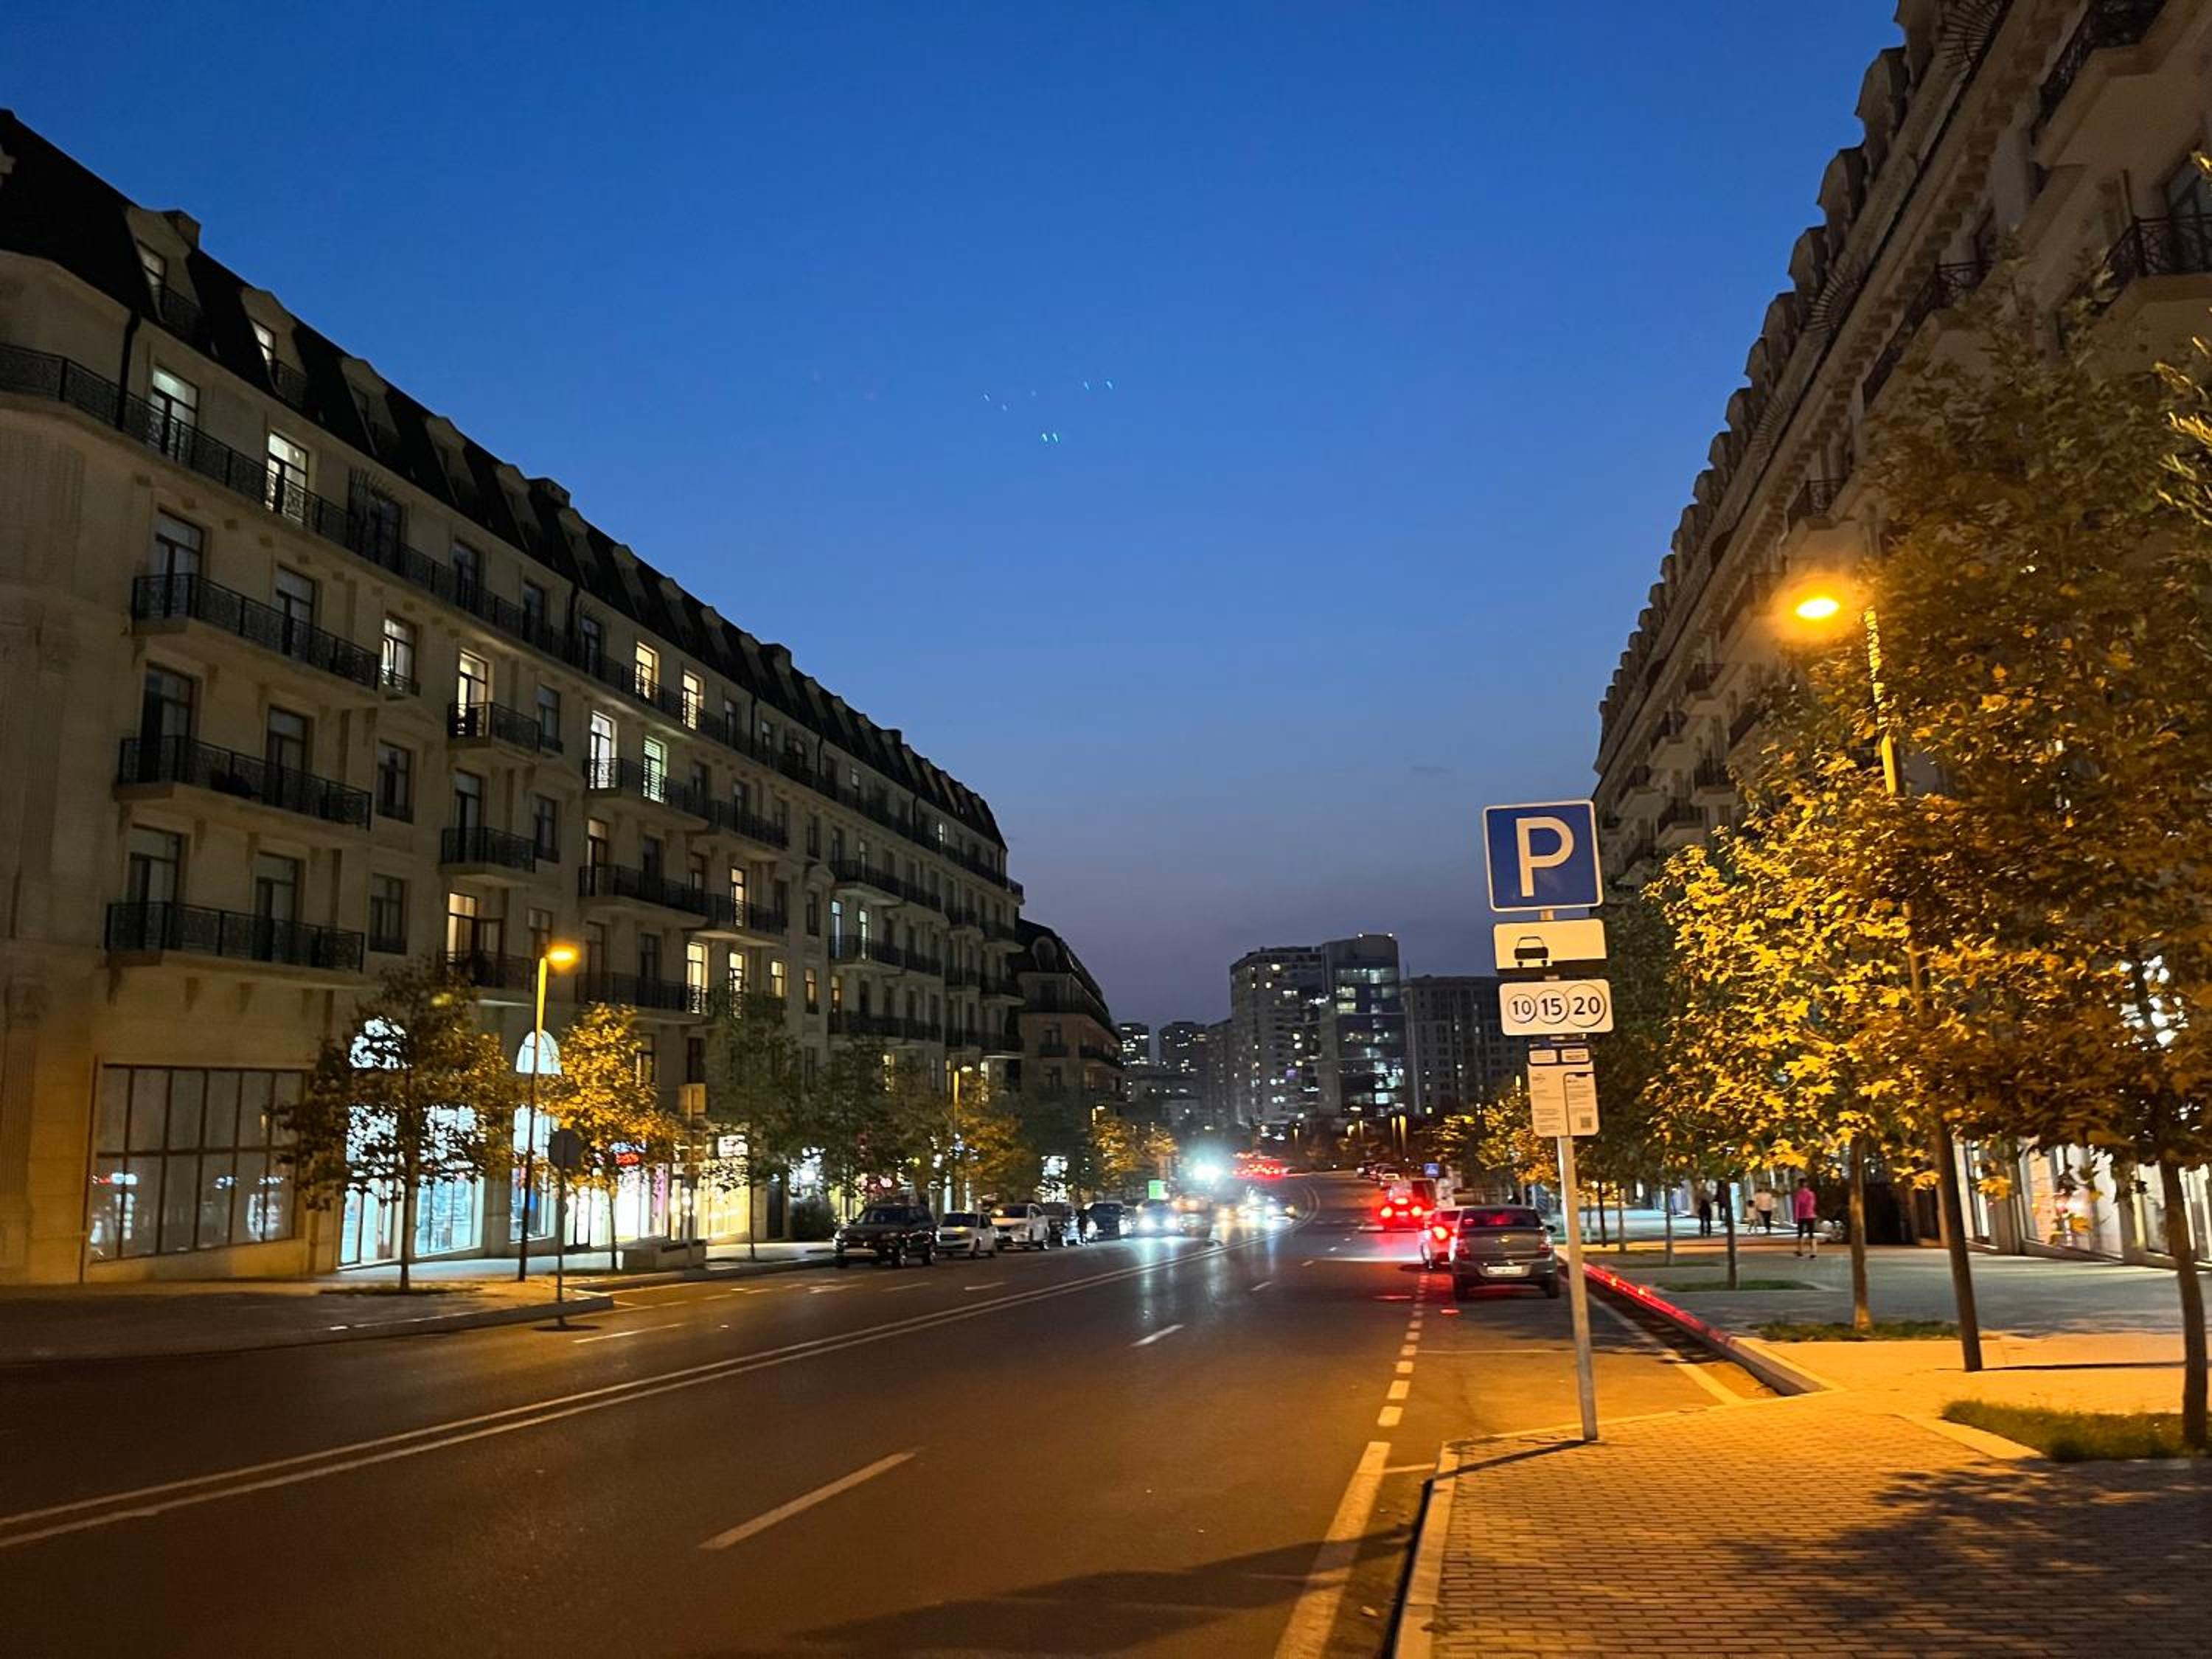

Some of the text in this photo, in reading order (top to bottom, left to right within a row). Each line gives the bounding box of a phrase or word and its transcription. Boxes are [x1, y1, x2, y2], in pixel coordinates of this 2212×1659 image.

[1516, 816, 1574, 897] P
[1512, 996, 1601, 1016] 10 15 20
